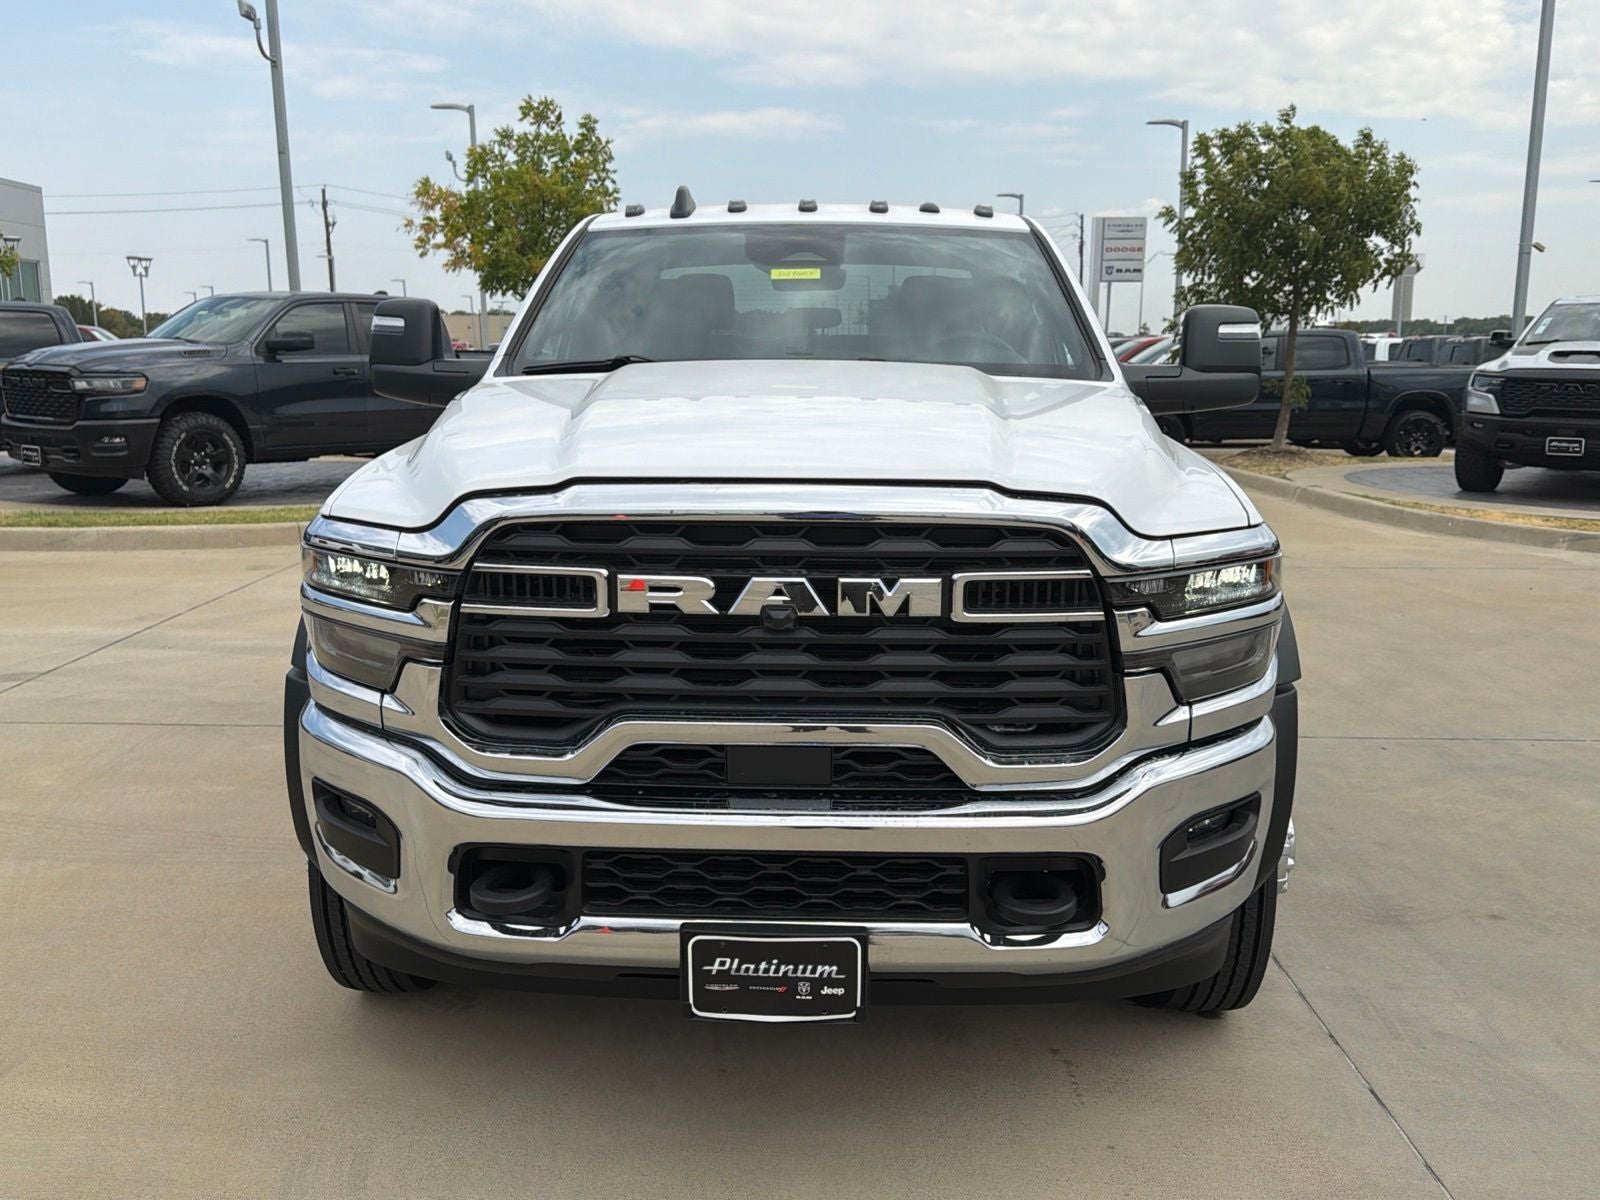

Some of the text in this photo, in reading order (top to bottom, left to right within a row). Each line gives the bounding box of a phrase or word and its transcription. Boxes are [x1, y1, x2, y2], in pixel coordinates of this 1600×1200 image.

[617, 574, 942, 617] RAM
[702, 957, 847, 978] Platinum
[820, 986, 845, 995] Jeep
